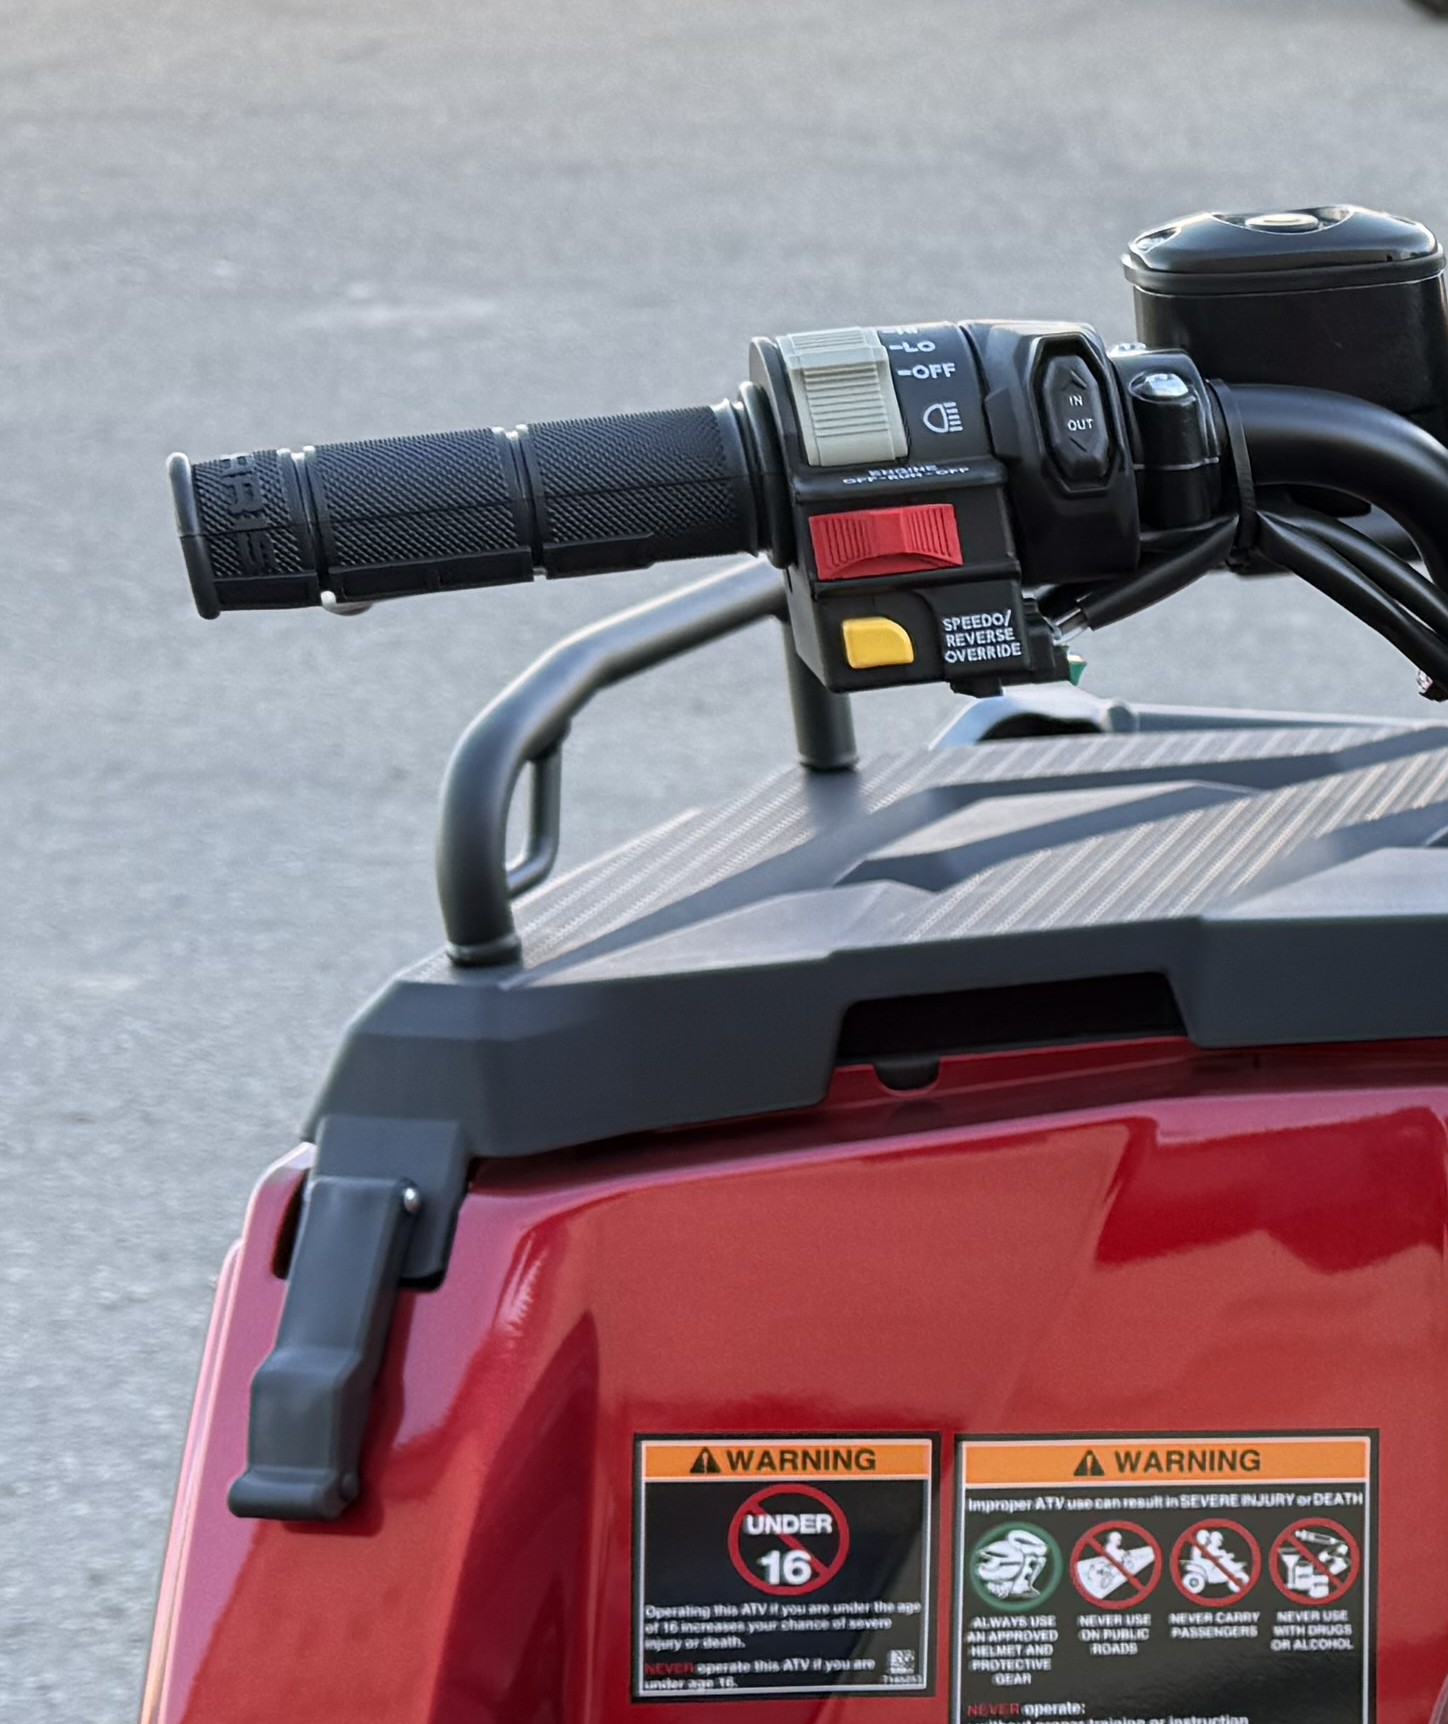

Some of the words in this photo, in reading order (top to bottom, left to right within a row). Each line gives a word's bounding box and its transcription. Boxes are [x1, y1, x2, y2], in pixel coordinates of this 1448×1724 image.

[902, 340, 936, 353] LO
[911, 362, 956, 379] OFF
[1069, 394, 1084, 406] IN
[1067, 418, 1094, 431] OUT
[868, 463, 938, 477] ENGINE
[942, 608, 1012, 632] SPEEDO/
[945, 627, 1016, 648] REVERSE
[944, 642, 1022, 663] OVERRIDE
[726, 1448, 875, 1471] WARNING
[1114, 1448, 1260, 1473] WARNING
[746, 1512, 835, 1535] UNDER
[758, 1549, 813, 1586] 16
